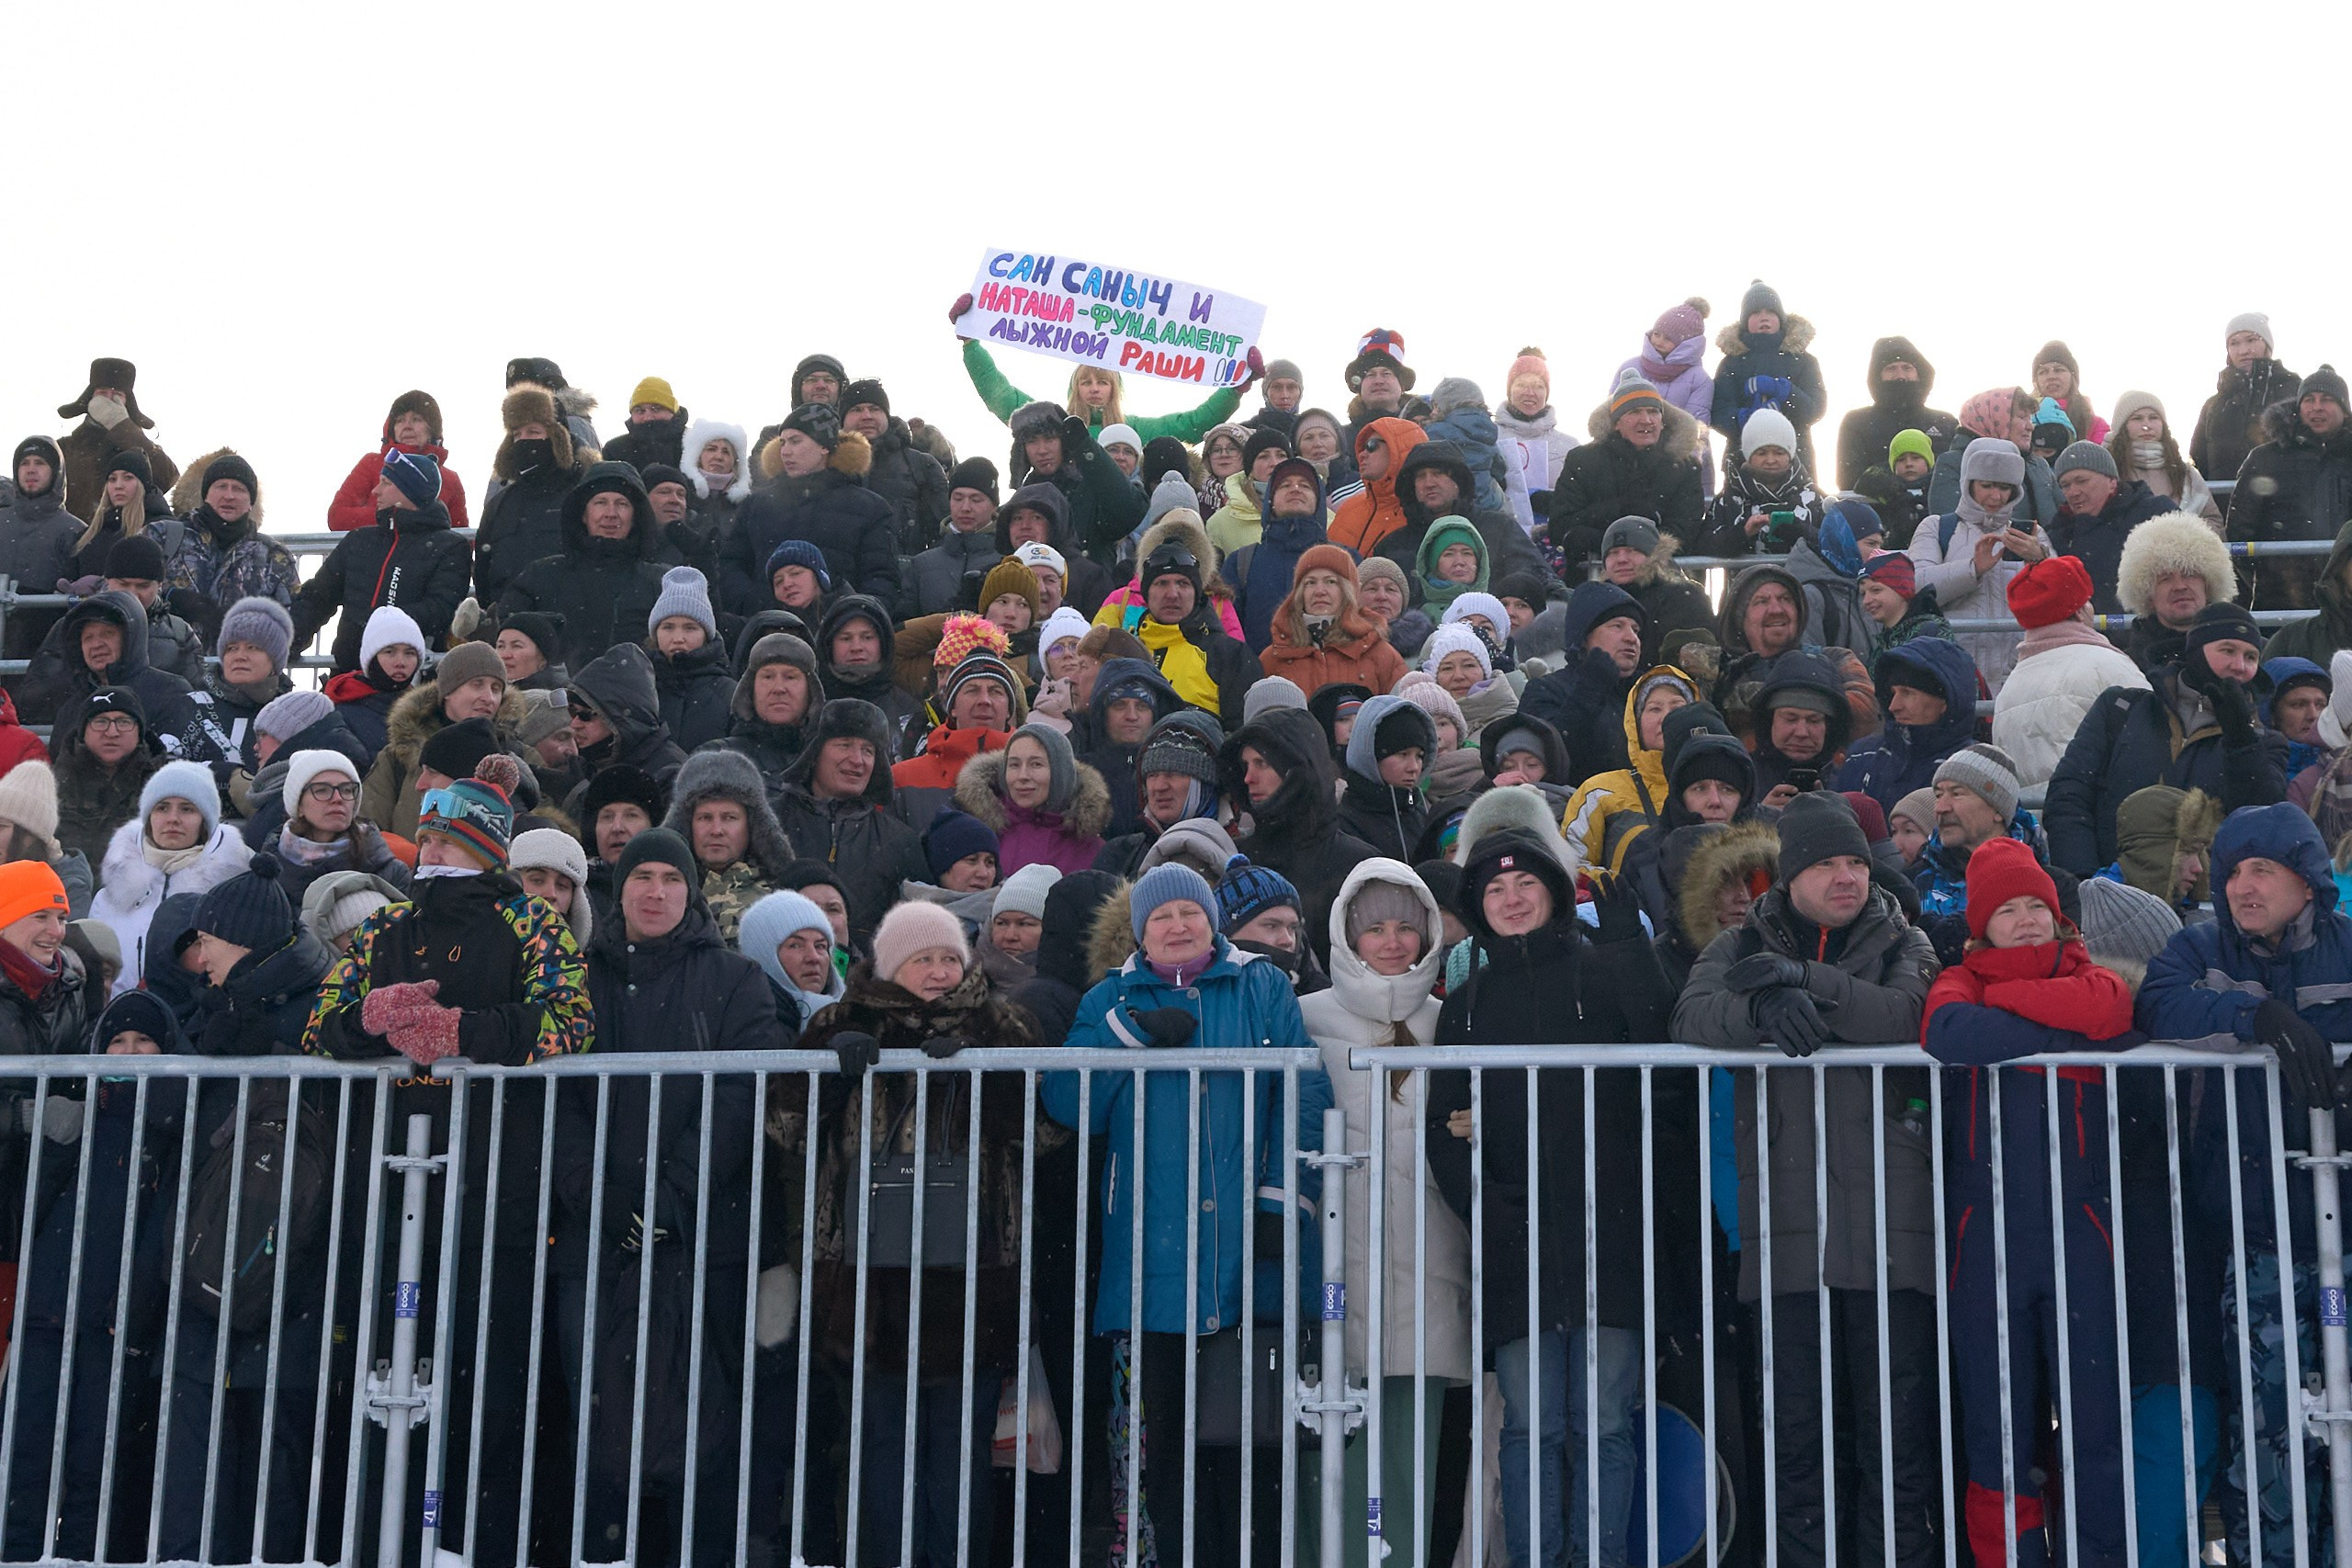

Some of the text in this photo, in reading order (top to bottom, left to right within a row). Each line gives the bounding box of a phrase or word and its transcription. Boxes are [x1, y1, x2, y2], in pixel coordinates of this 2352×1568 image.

[989, 253, 1215, 324] САН САНЫЧ И
[989, 317, 1110, 359] ЛЫЖНОЙ
[1119, 341, 1205, 382] РАШИ
[386, 566, 401, 606] MADSH
